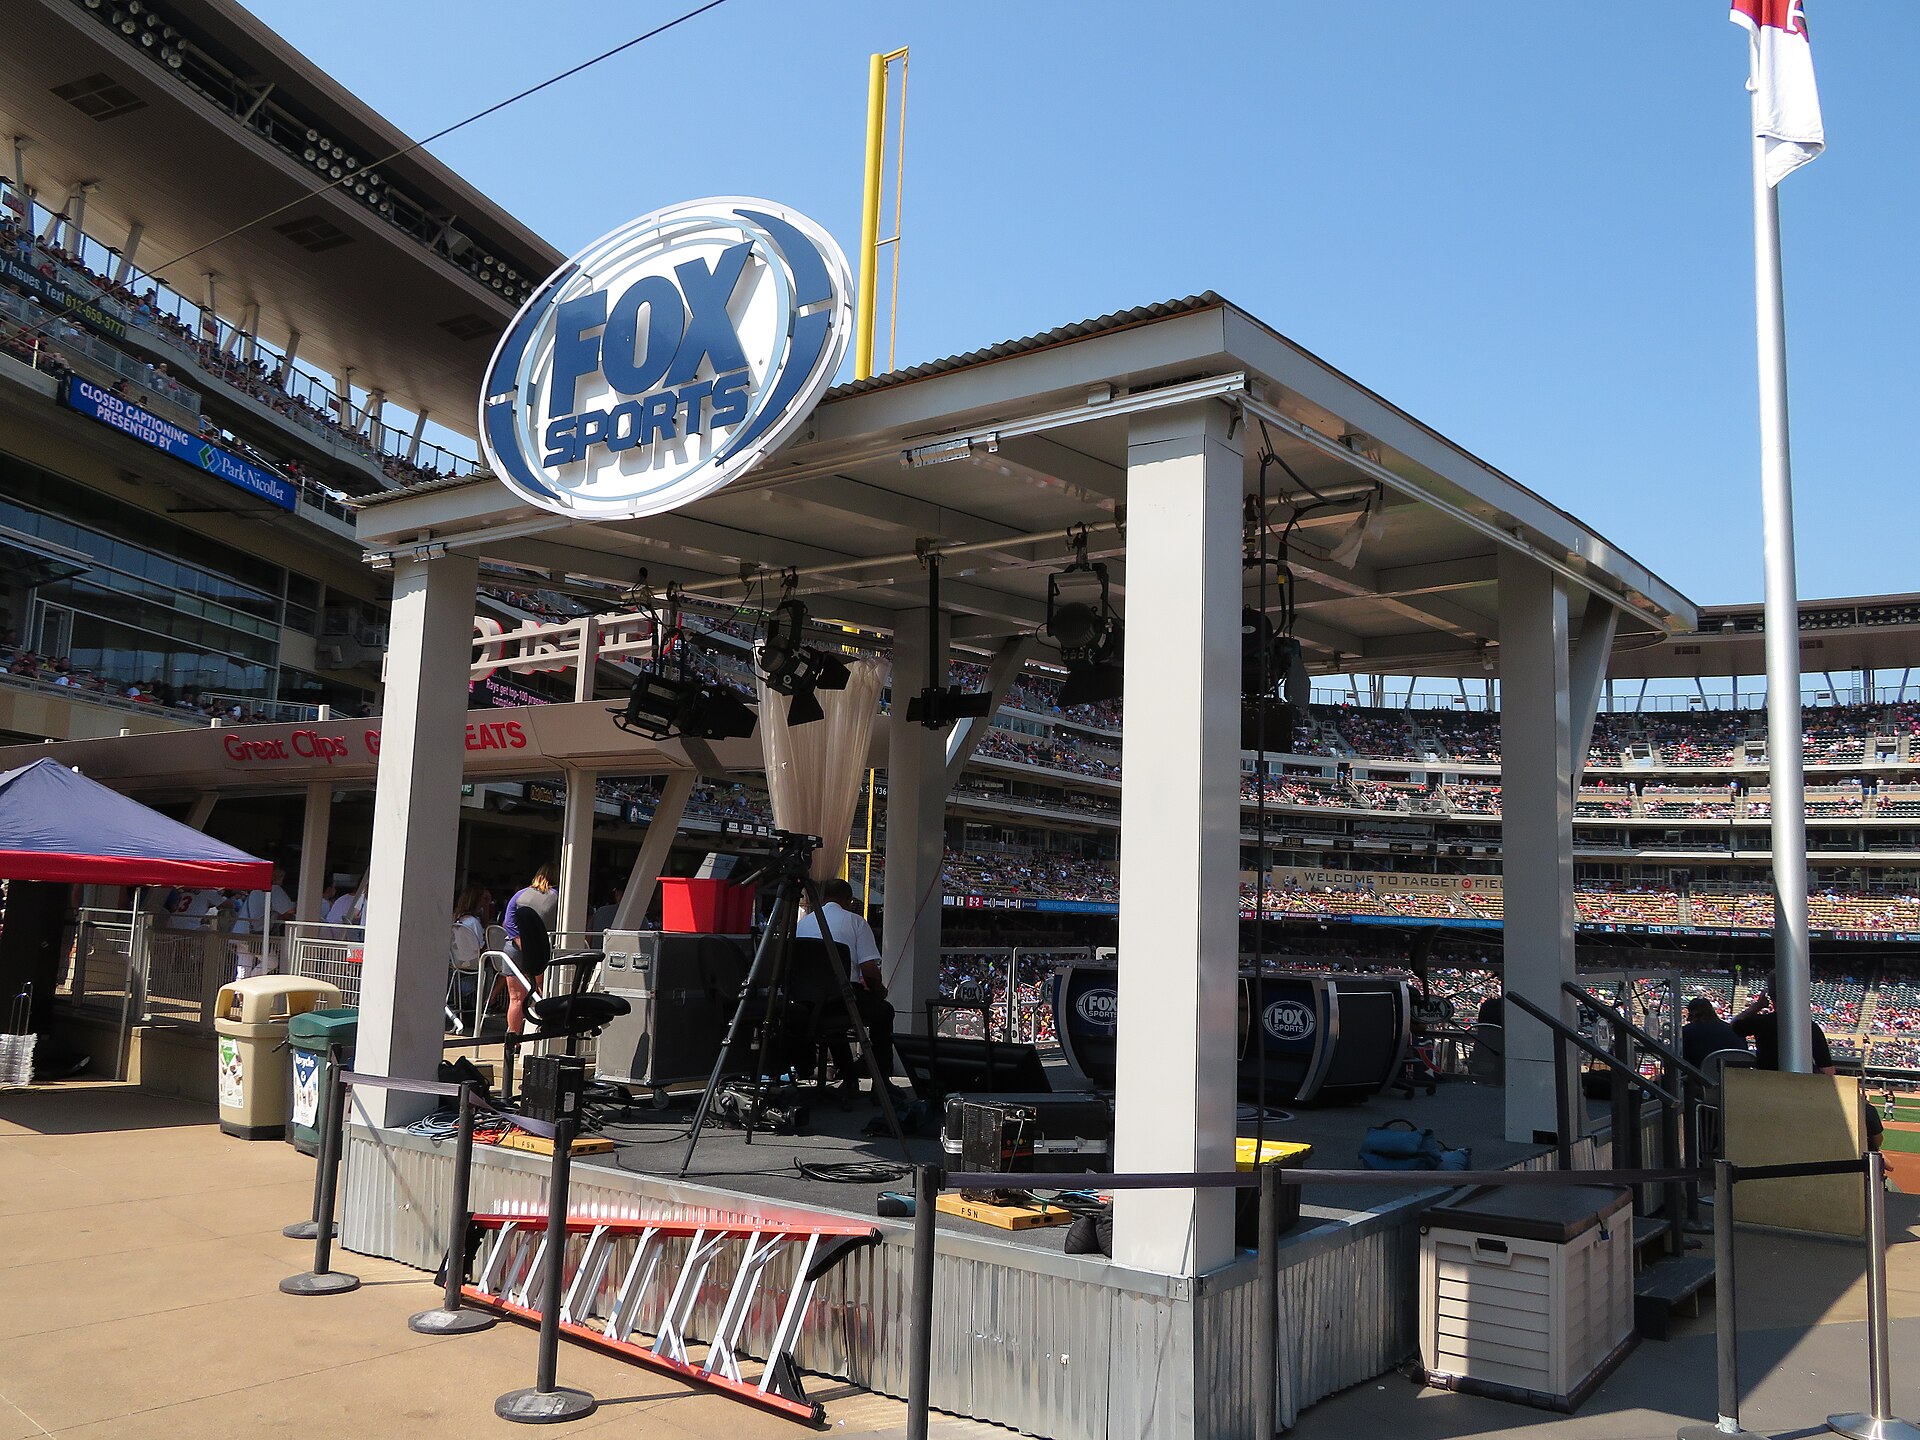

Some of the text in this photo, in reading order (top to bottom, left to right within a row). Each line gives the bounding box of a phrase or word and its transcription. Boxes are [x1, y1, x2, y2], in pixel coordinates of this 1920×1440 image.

[8, 260, 42, 291] Issues.
[45, 281, 65, 304] Text
[65, 294, 126, 337] 612-659-3777
[549, 240, 755, 419] FOX
[79, 382, 189, 446] CLOSED CAPTIONING
[96, 405, 172, 451] PRESENTED BY
[543, 372, 750, 468] SPORTS
[221, 457, 284, 501] Park Nicollet
[485, 678, 499, 694] Rays
[224, 734, 289, 761] Great
[291, 730, 348, 764] Clips
[1304, 871, 1375, 884] WELCOME
[1379, 875, 1398, 885] TO
[1402, 876, 1459, 888] TARGET
[962, 986, 978, 999] FOX
[1089, 996, 1117, 1011] FOX
[1274, 1008, 1304, 1025] FOX
[1274, 1024, 1304, 1033] SPORTS
